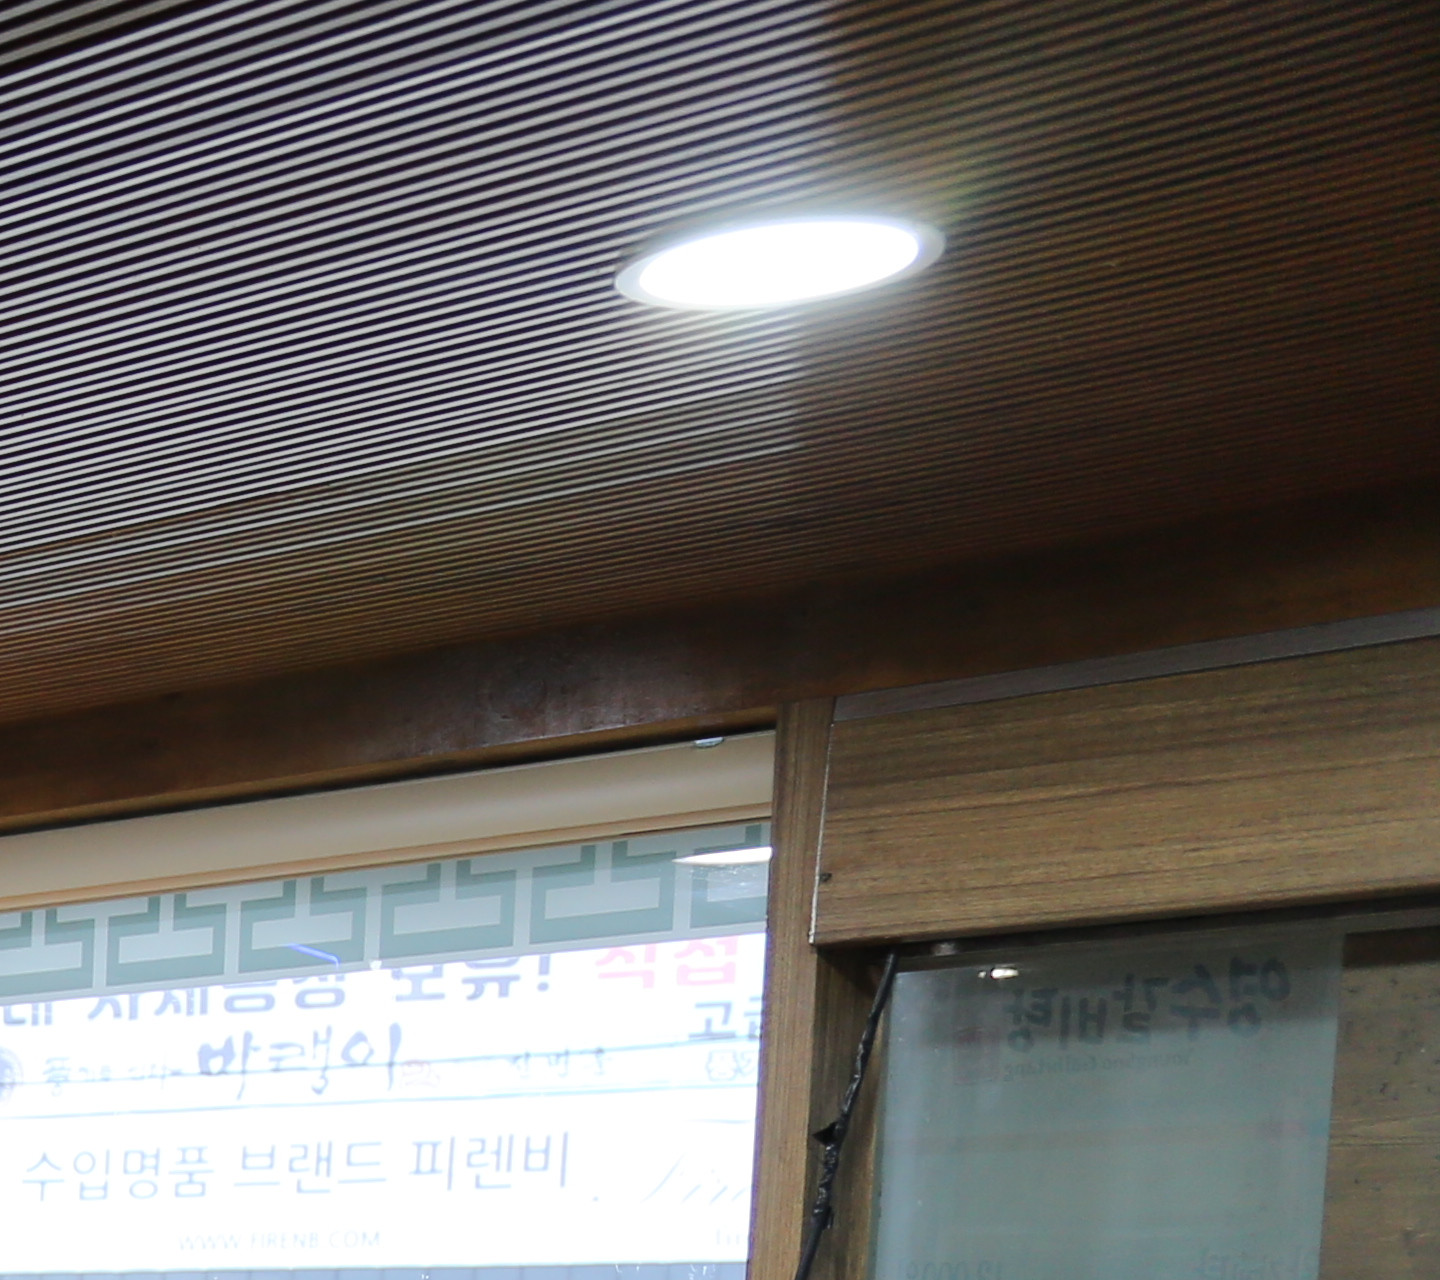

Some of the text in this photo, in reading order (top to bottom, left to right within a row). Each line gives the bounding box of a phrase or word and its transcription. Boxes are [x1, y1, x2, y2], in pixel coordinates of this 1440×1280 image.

[22, 1131, 569, 1200] 수입명품 브랜드 피렌비
